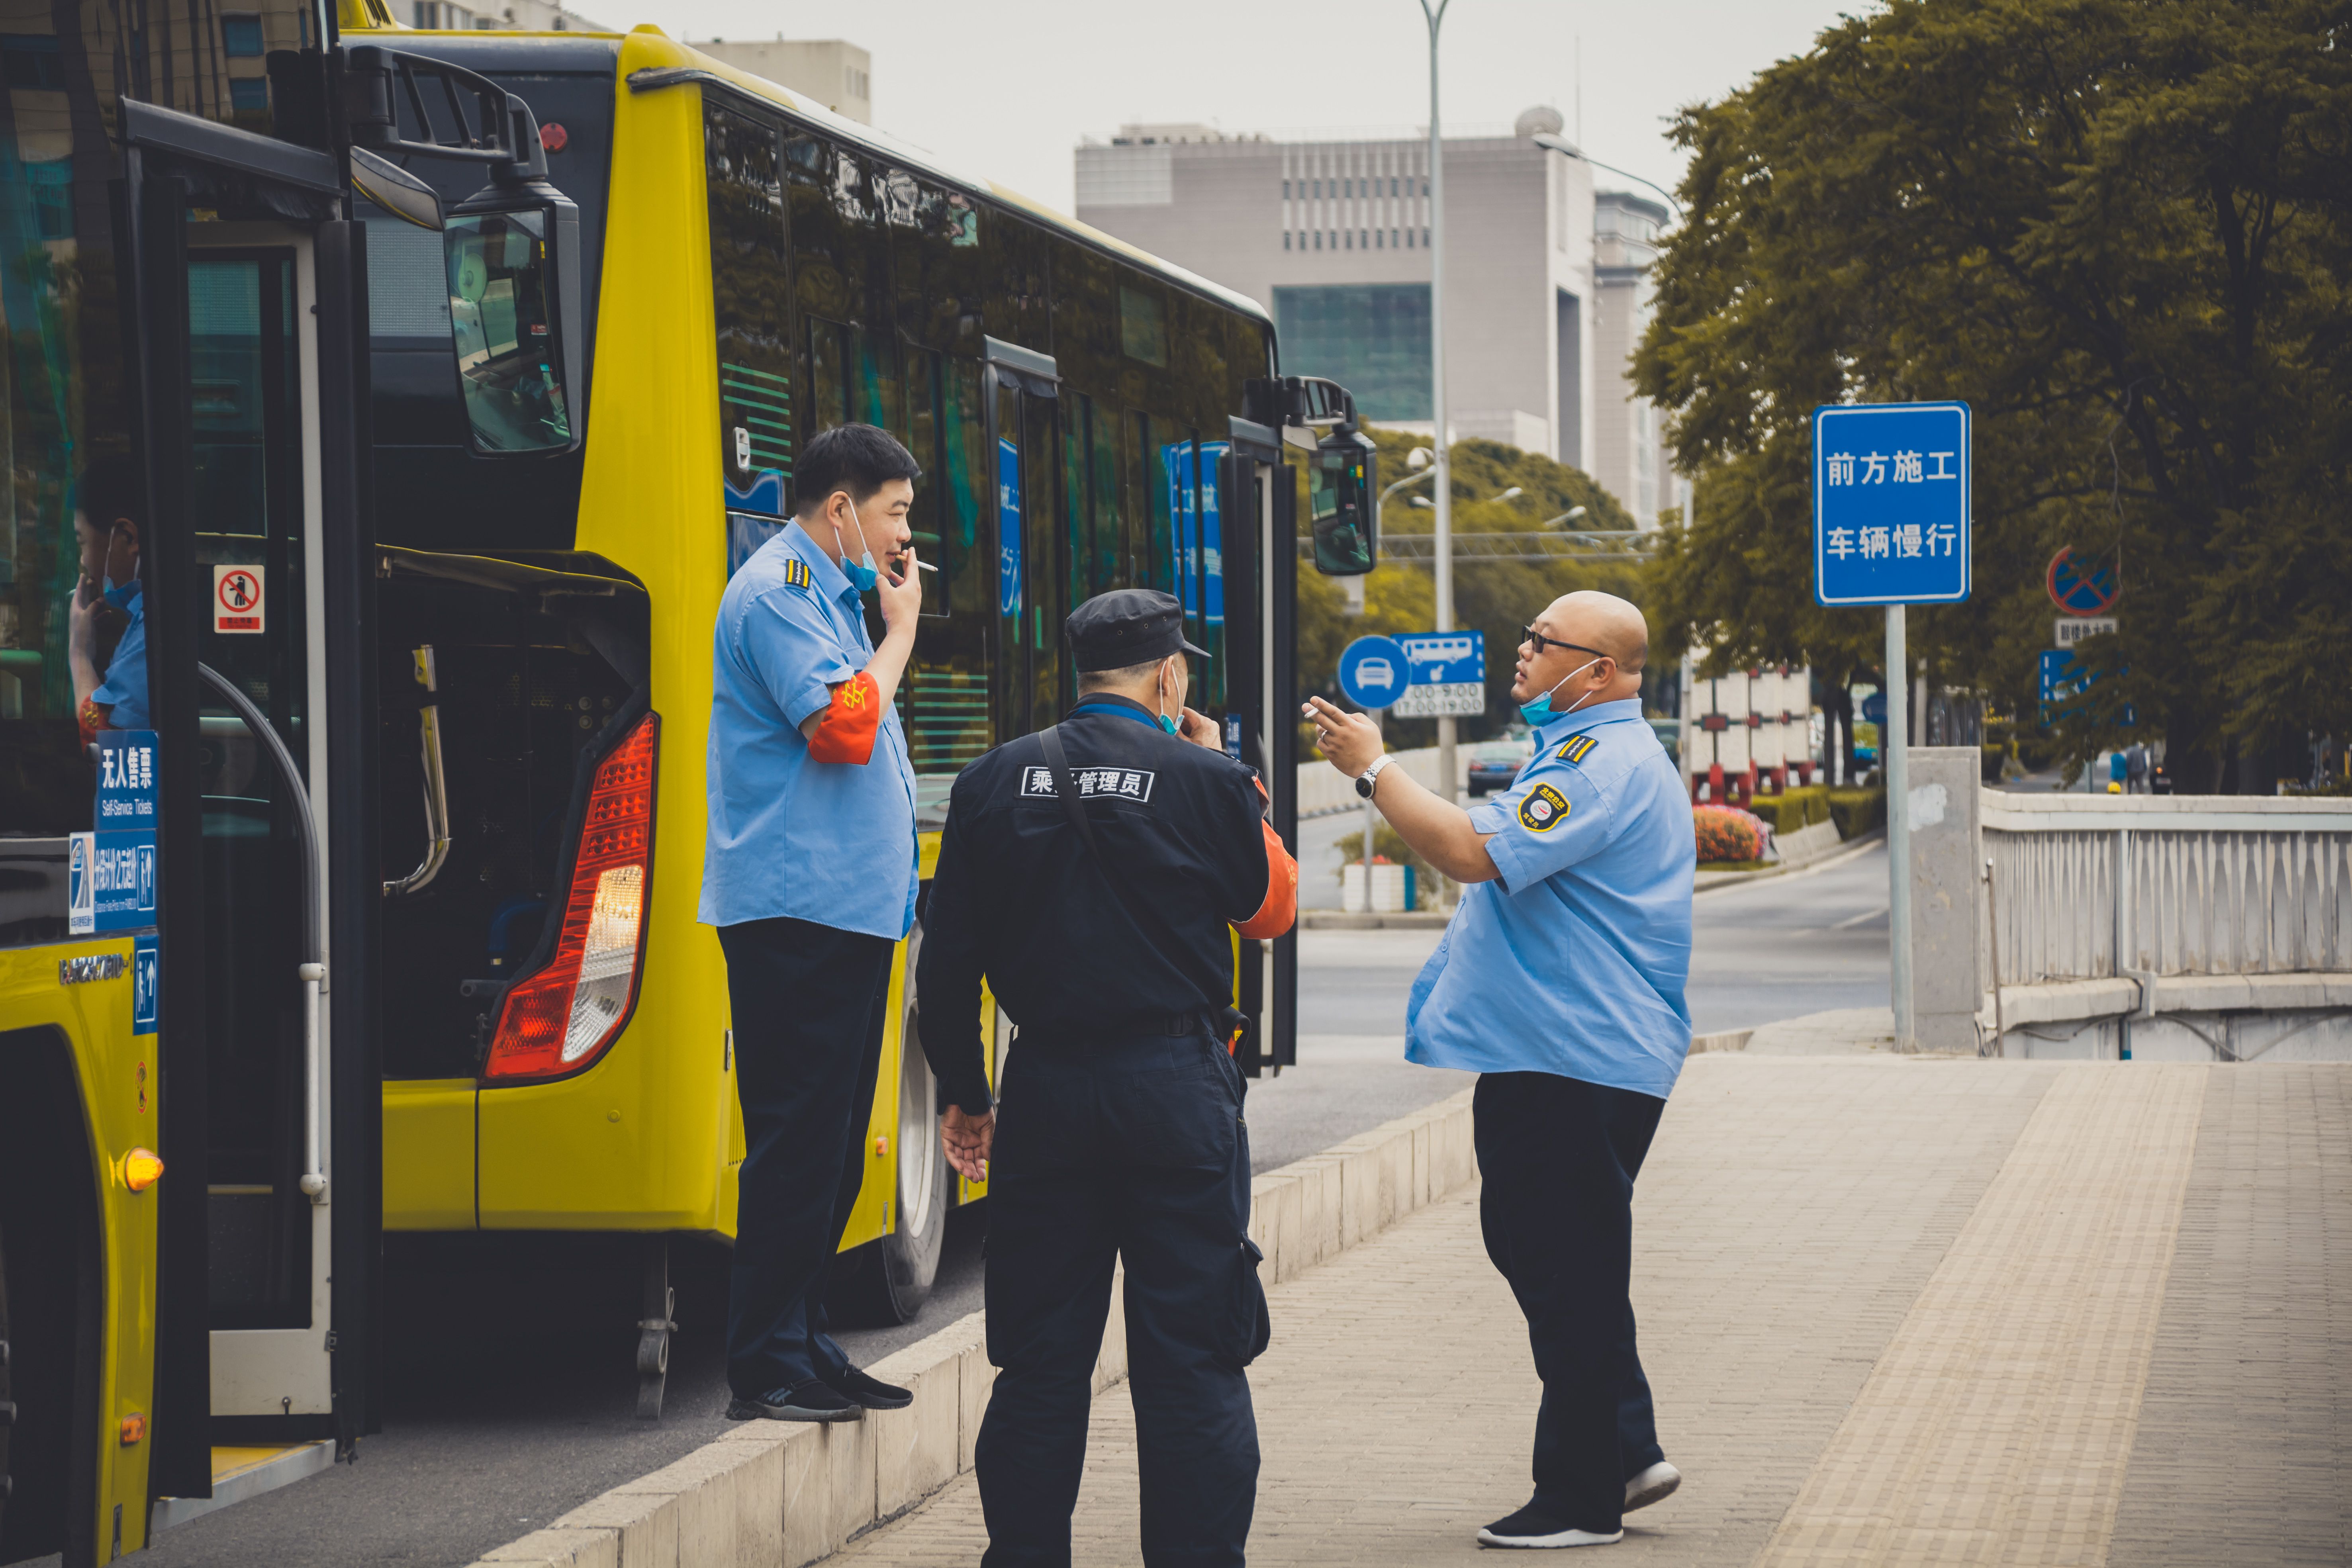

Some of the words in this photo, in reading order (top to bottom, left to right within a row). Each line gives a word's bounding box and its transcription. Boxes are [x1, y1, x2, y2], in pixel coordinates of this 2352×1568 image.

[1826, 450, 1956, 486] 前方施工
[1827, 523, 1956, 560] 车辆慢行
[1411, 684, 1479, 699] :00-9:00
[102, 746, 152, 789] 无人售票
[1031, 770, 1142, 796] 乘管理员
[102, 799, 133, 816] Self-Service
[134, 799, 152, 814] Tickets
[1541, 786, 1565, 809] 北京公交
[1522, 812, 1539, 828] 驾驶员
